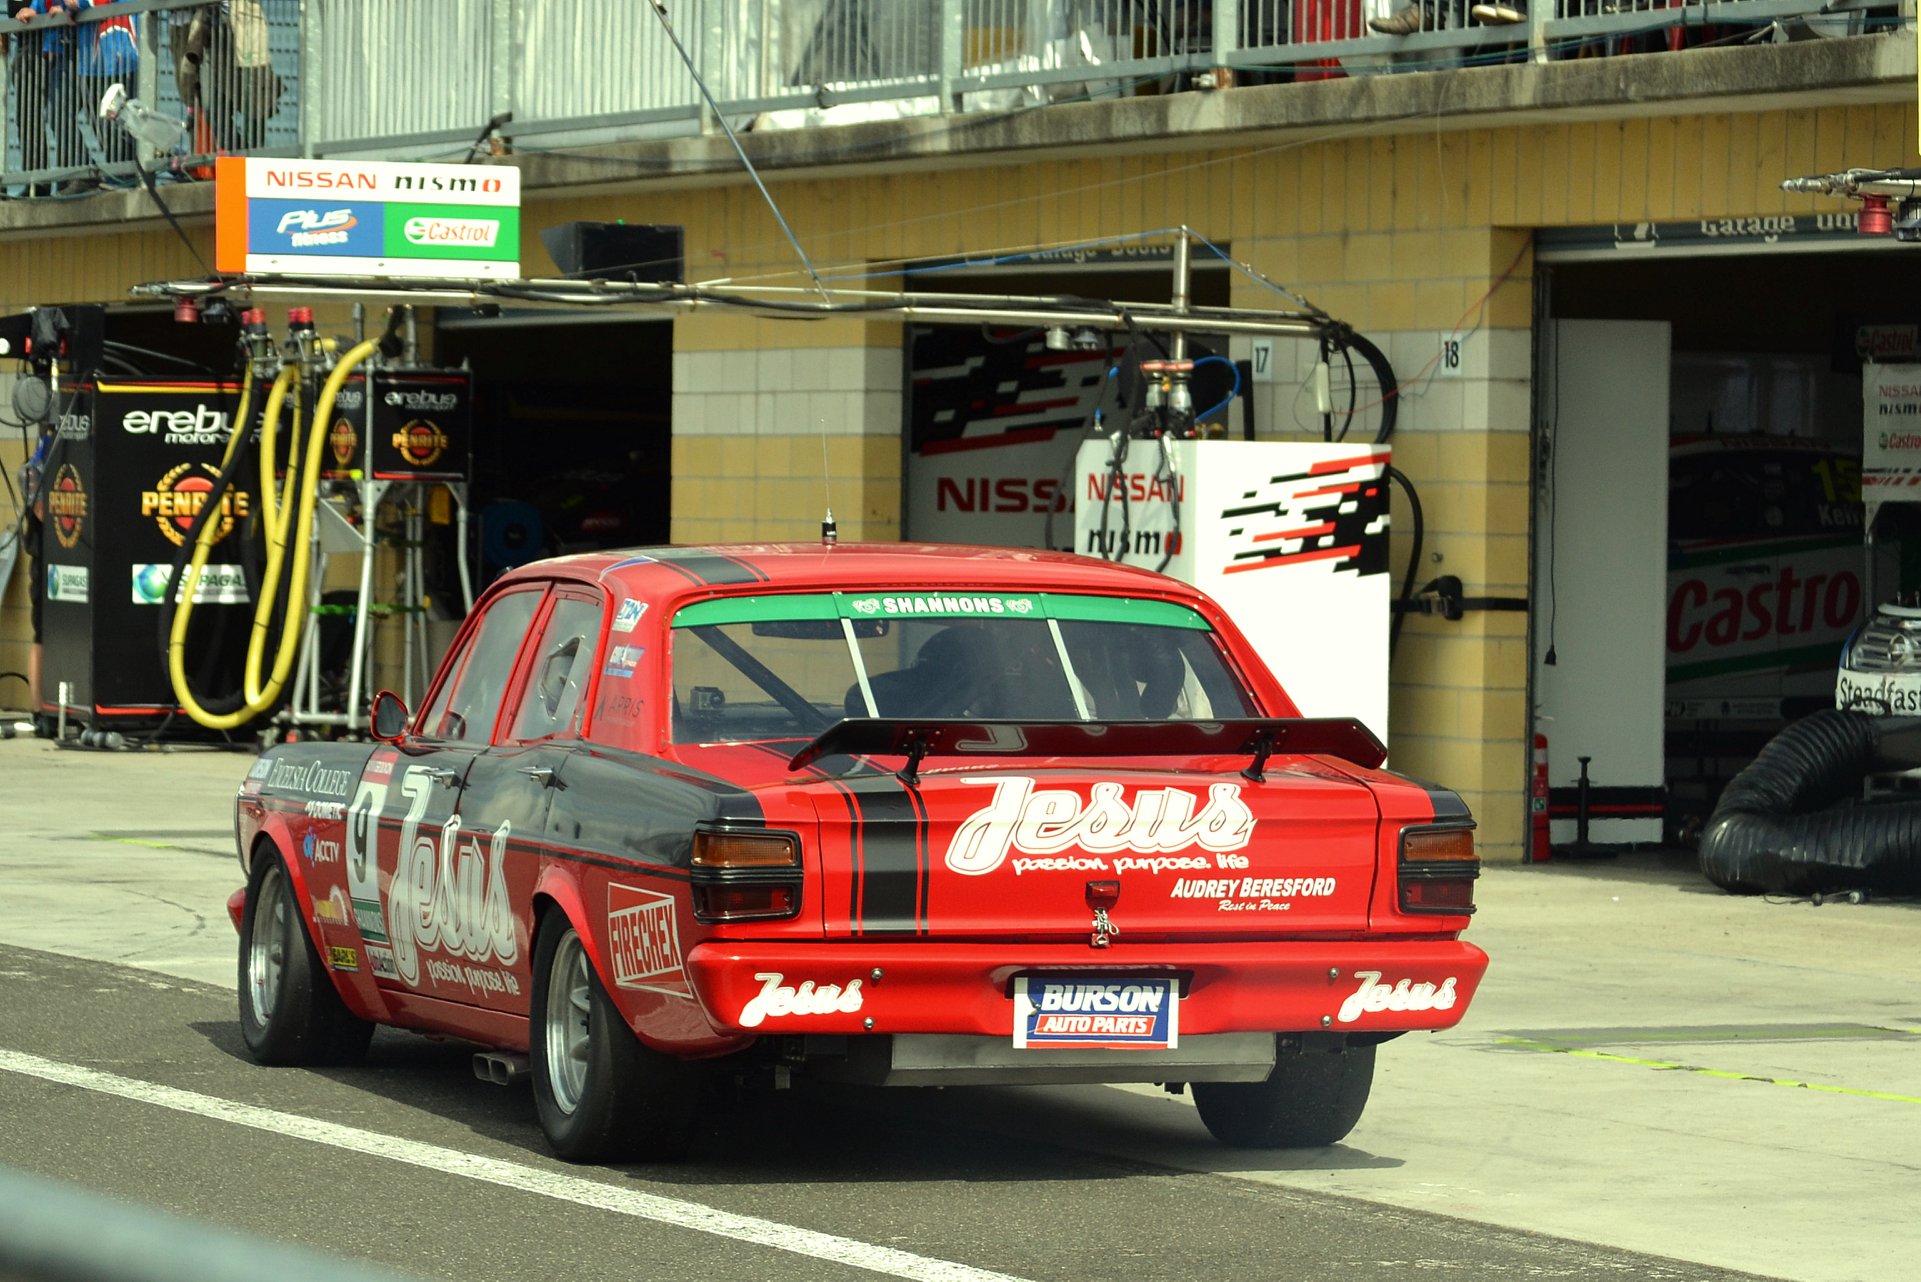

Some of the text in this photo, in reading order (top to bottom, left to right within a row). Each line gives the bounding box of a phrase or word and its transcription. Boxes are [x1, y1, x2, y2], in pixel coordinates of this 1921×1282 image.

[267, 171, 501, 193] NISSAN nismo
[276, 208, 353, 234] Plus
[428, 221, 490, 241] Castrol
[1256, 347, 1270, 373] 17
[1444, 341, 1460, 368] 18
[1879, 384, 1921, 398] NISSA
[392, 432, 449, 448] PENRITE
[936, 477, 1076, 513] NISS
[882, 597, 1004, 614] SHANNONS
[1840, 674, 1921, 712] Steadfas
[305, 760, 351, 796] COLLEGE
[354, 790, 373, 884] 9
[944, 776, 1257, 876] Jesus
[1216, 853, 1250, 870] life
[388, 765, 518, 988] Jesus
[1170, 877, 1336, 899] AUDREY BERESFORD
[1218, 899, 1291, 912] Rest in Peace
[608, 903, 682, 981] FIRECHEX
[738, 973, 864, 1028] Jesus
[1043, 984, 1164, 1013] BURSON
[1337, 970, 1457, 1023] Jesus
[1043, 1016, 1149, 1035] AUTO PARTS
